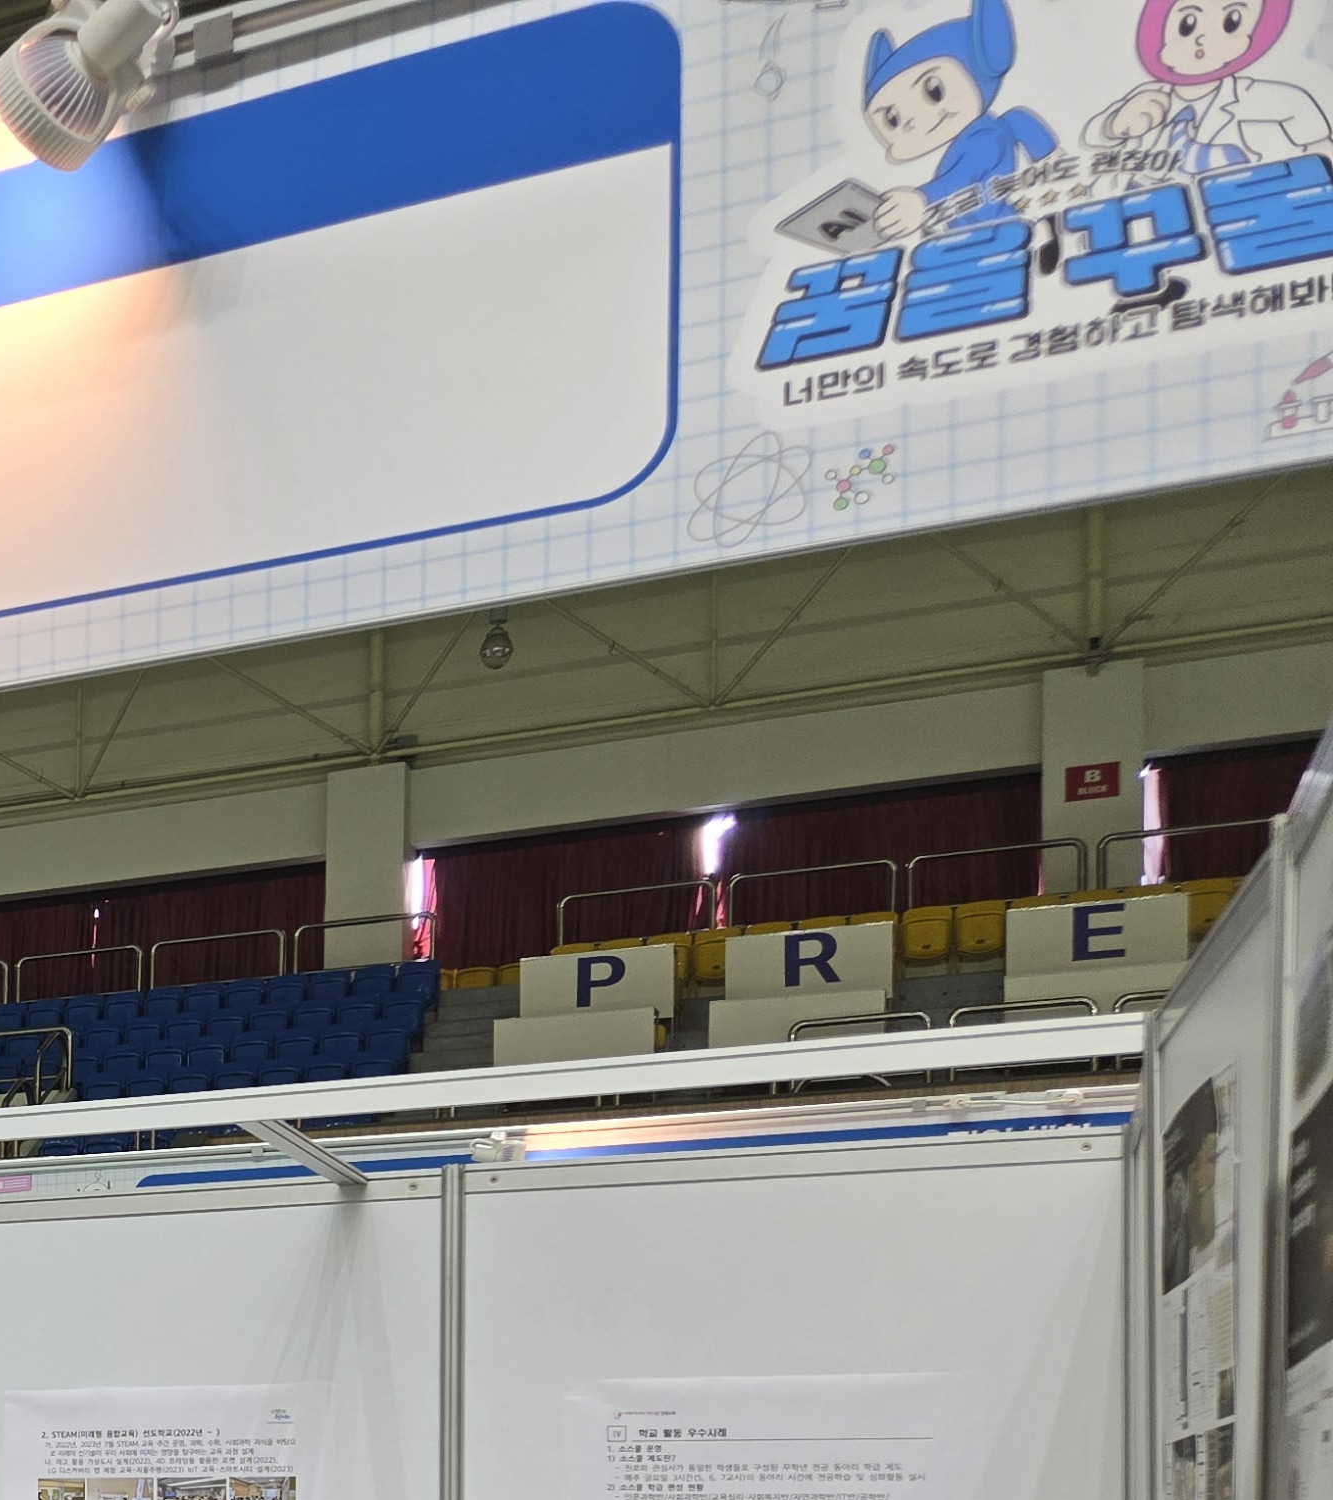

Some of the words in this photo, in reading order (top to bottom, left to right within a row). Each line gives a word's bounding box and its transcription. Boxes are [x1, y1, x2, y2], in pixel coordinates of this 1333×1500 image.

[1091, 148, 1182, 174] 괜찮아
[818, 208, 868, 242] AI
[783, 362, 884, 407] 너만의
[897, 339, 1000, 382] 속도로
[1009, 304, 1160, 363] 경험하고
[1171, 273, 1333, 332] 탐색해봐
[1084, 769, 1102, 784] B
[575, 956, 626, 1008] P
[783, 932, 841, 987] R
[1071, 902, 1127, 962] E
[638, 1428, 658, 1438] 학교
[662, 1428, 682, 1438] 활동
[687, 1427, 727, 1438] 우수사례
